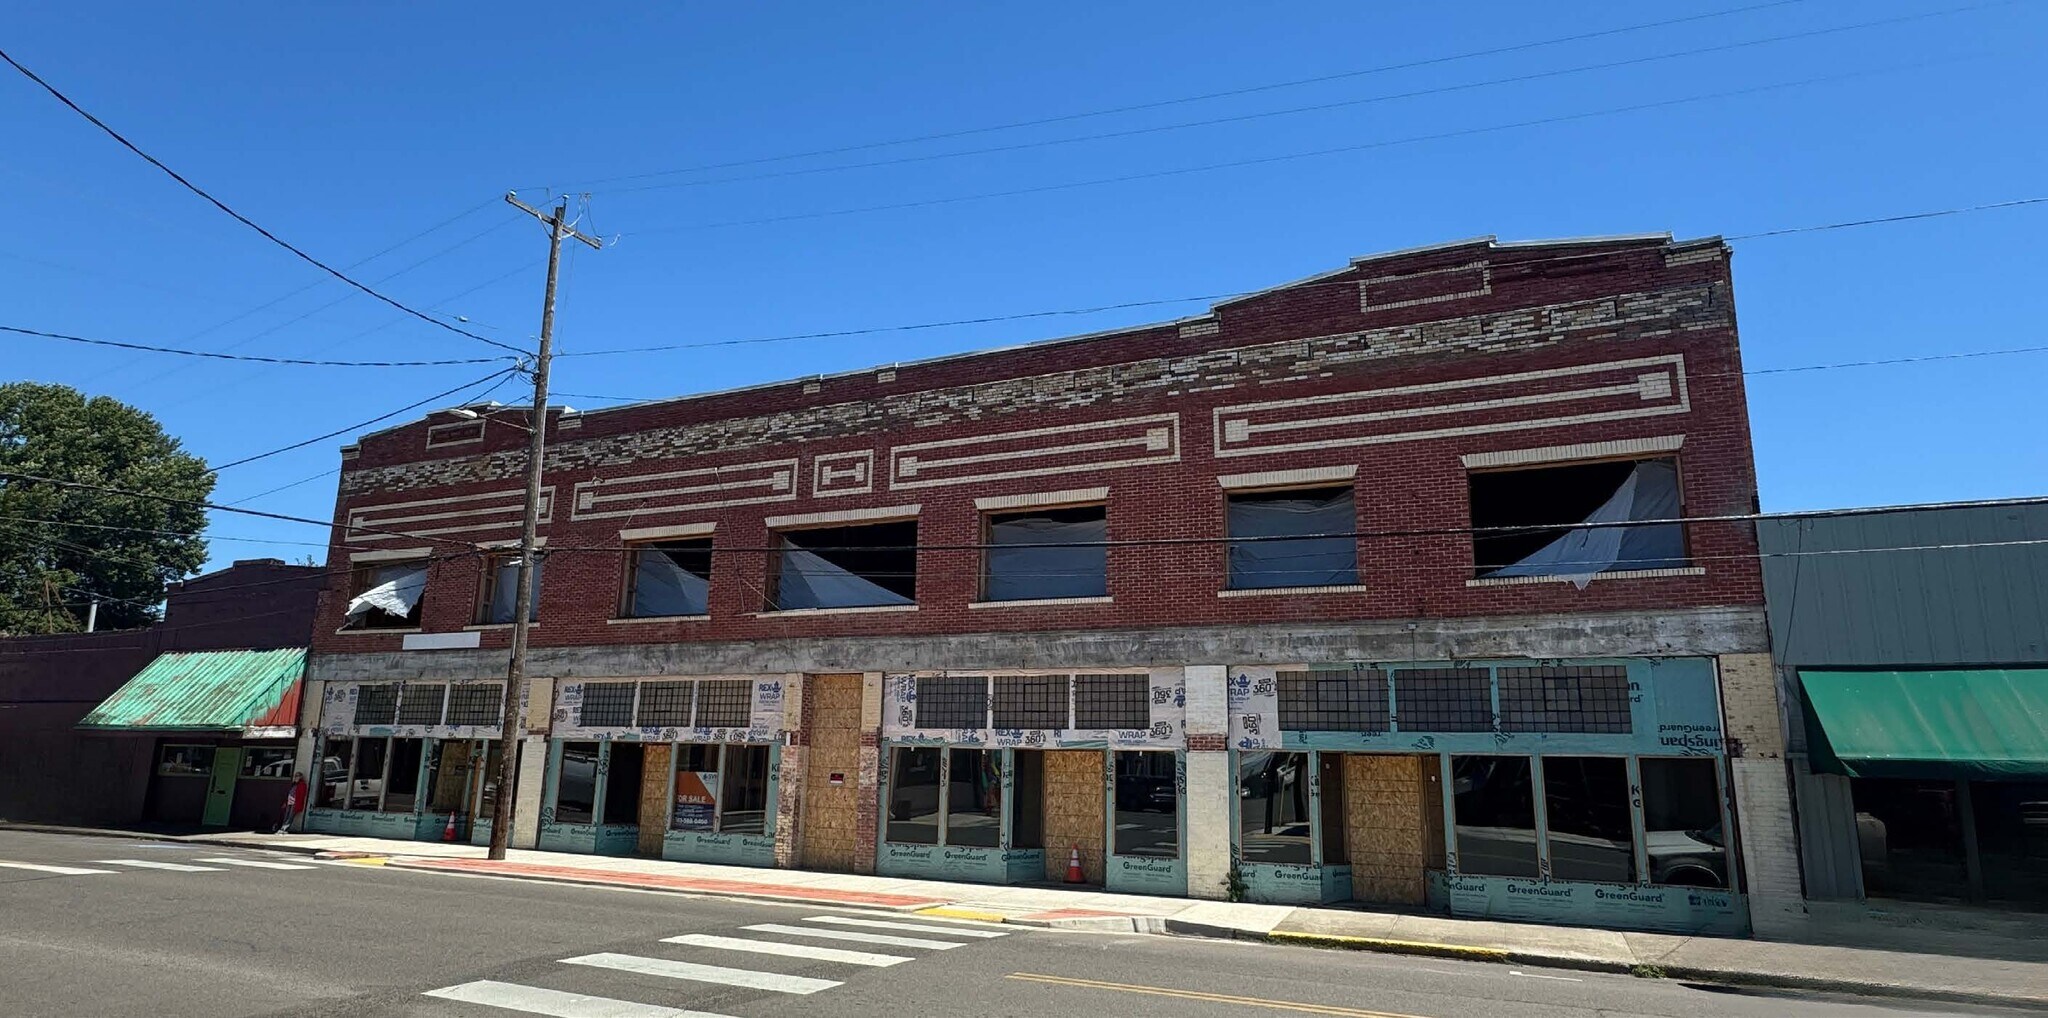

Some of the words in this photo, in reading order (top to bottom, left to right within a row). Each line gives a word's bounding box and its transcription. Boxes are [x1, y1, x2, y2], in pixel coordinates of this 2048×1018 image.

[760, 692, 780, 700] WRAP
[1659, 724, 1720, 733] reenGuard
[1118, 731, 1147, 739] WRAP
[997, 738, 1022, 746] WRAP
[697, 835, 732, 845] GreenGuard
[890, 849, 930, 858] GreenGuard
[945, 850, 988, 861] GreenGuard
[1123, 861, 1172, 873] GreenGuard
[1507, 884, 1573, 897] GreenGuard
[1595, 889, 1663, 903] GreenGuard
